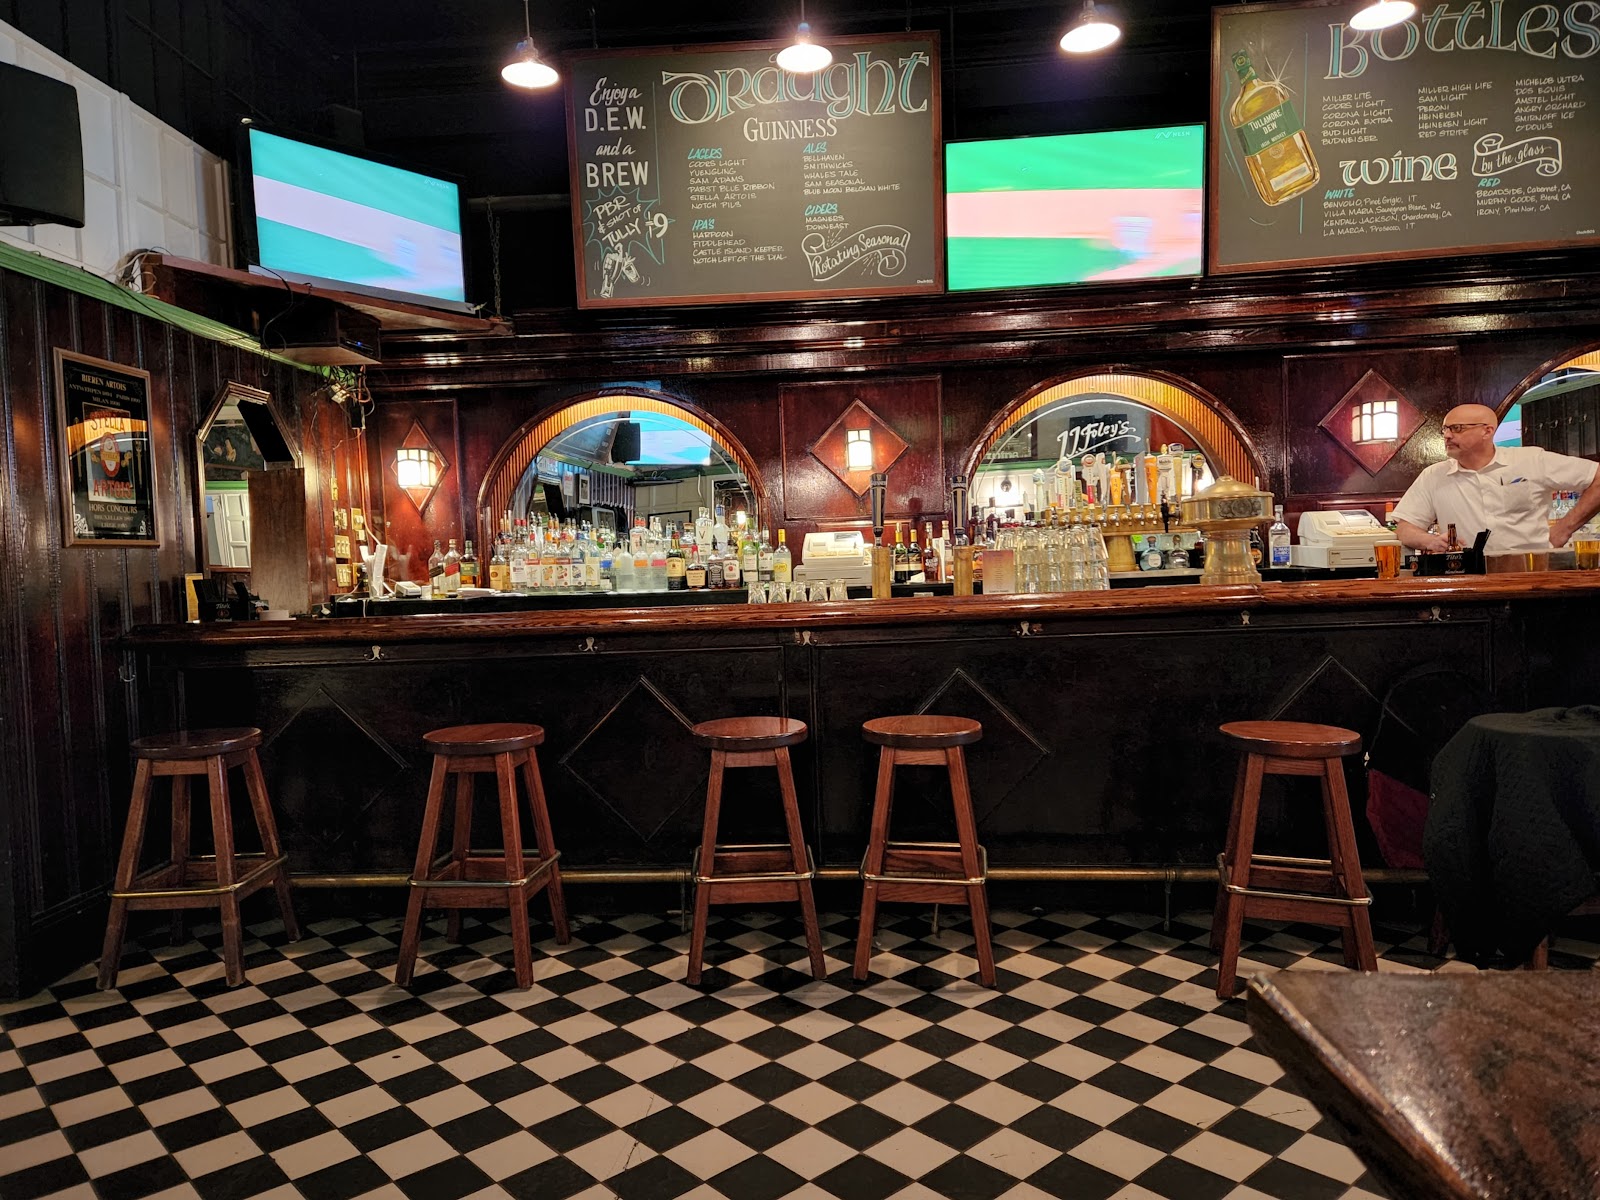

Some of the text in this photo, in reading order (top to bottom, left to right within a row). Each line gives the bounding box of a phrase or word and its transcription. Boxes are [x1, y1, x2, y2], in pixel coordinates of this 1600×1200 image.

[1515, 75, 1584, 86] MICHELOB ULTRA
[590, 77, 642, 106] Enjoy a
[1418, 81, 1493, 94] MILLER HIGH LIFE
[1514, 88, 1534, 96] DOS
[1323, 92, 1372, 103] MILLER LITE
[1441, 93, 1467, 101] LIGHT
[1515, 93, 1576, 104] AMSTEL LIGHT
[1322, 100, 1385, 111] COORS LIGHT
[1417, 104, 1450, 112] PERONI
[1514, 101, 1586, 114] ANGRY ORCHARD
[585, 106, 646, 132] D.E.W.
[1248, 109, 1282, 131] TULLAMORE
[1323, 110, 1360, 119] CORONA
[1418, 111, 1463, 120] HEINEKEN
[1515, 113, 1557, 122] SMIRNOFF
[1262, 121, 1277, 134] DEW
[1322, 117, 1393, 128] CORONA EXTRA
[1418, 118, 1488, 130] HEINEKEN LIGHT
[1321, 135, 1378, 145] BUDWEISER
[596, 137, 636, 155] and a
[803, 142, 827, 154] ALES
[688, 148, 722, 159] LAGERS
[803, 154, 845, 162] BELLHAVEN
[1481, 143, 1552, 173] by the glass
[804, 161, 853, 170] SMITHWICKS
[586, 161, 648, 187] BREW
[690, 168, 737, 176] YUENGLING
[713, 175, 744, 183] ADAMS
[825, 178, 865, 186] SEASONAL
[1478, 178, 1501, 187] RED
[688, 185, 716, 193] PABST
[743, 182, 775, 191] RIBBON
[878, 183, 900, 192] WHITE
[1476, 188, 1525, 198] BROADSIDE,
[690, 193, 719, 201] STELLA
[1324, 188, 1355, 199] WHITE
[593, 196, 630, 219] PBR
[1477, 198, 1507, 206] MURPHY
[805, 202, 838, 216] CIDERS
[1540, 204, 1550, 212] CA
[606, 208, 631, 227] SHOT
[633, 204, 641, 213] OF
[645, 211, 668, 238] $9
[805, 223, 849, 231] DOWNEAST
[1324, 219, 1357, 227] KENDALL
[602, 218, 641, 247] TULLY
[693, 231, 733, 239] HARPOON
[693, 239, 745, 248] FIDDLEHEAD
[693, 248, 721, 256] CASTLE
[815, 233, 908, 276] Rotating Seasonal
[81, 374, 126, 391] BIEREN ARTOIS
[90, 410, 126, 435] STELLA
[94, 479, 132, 499] ARTOIS
[89, 503, 137, 514] HORS CONCOURS
